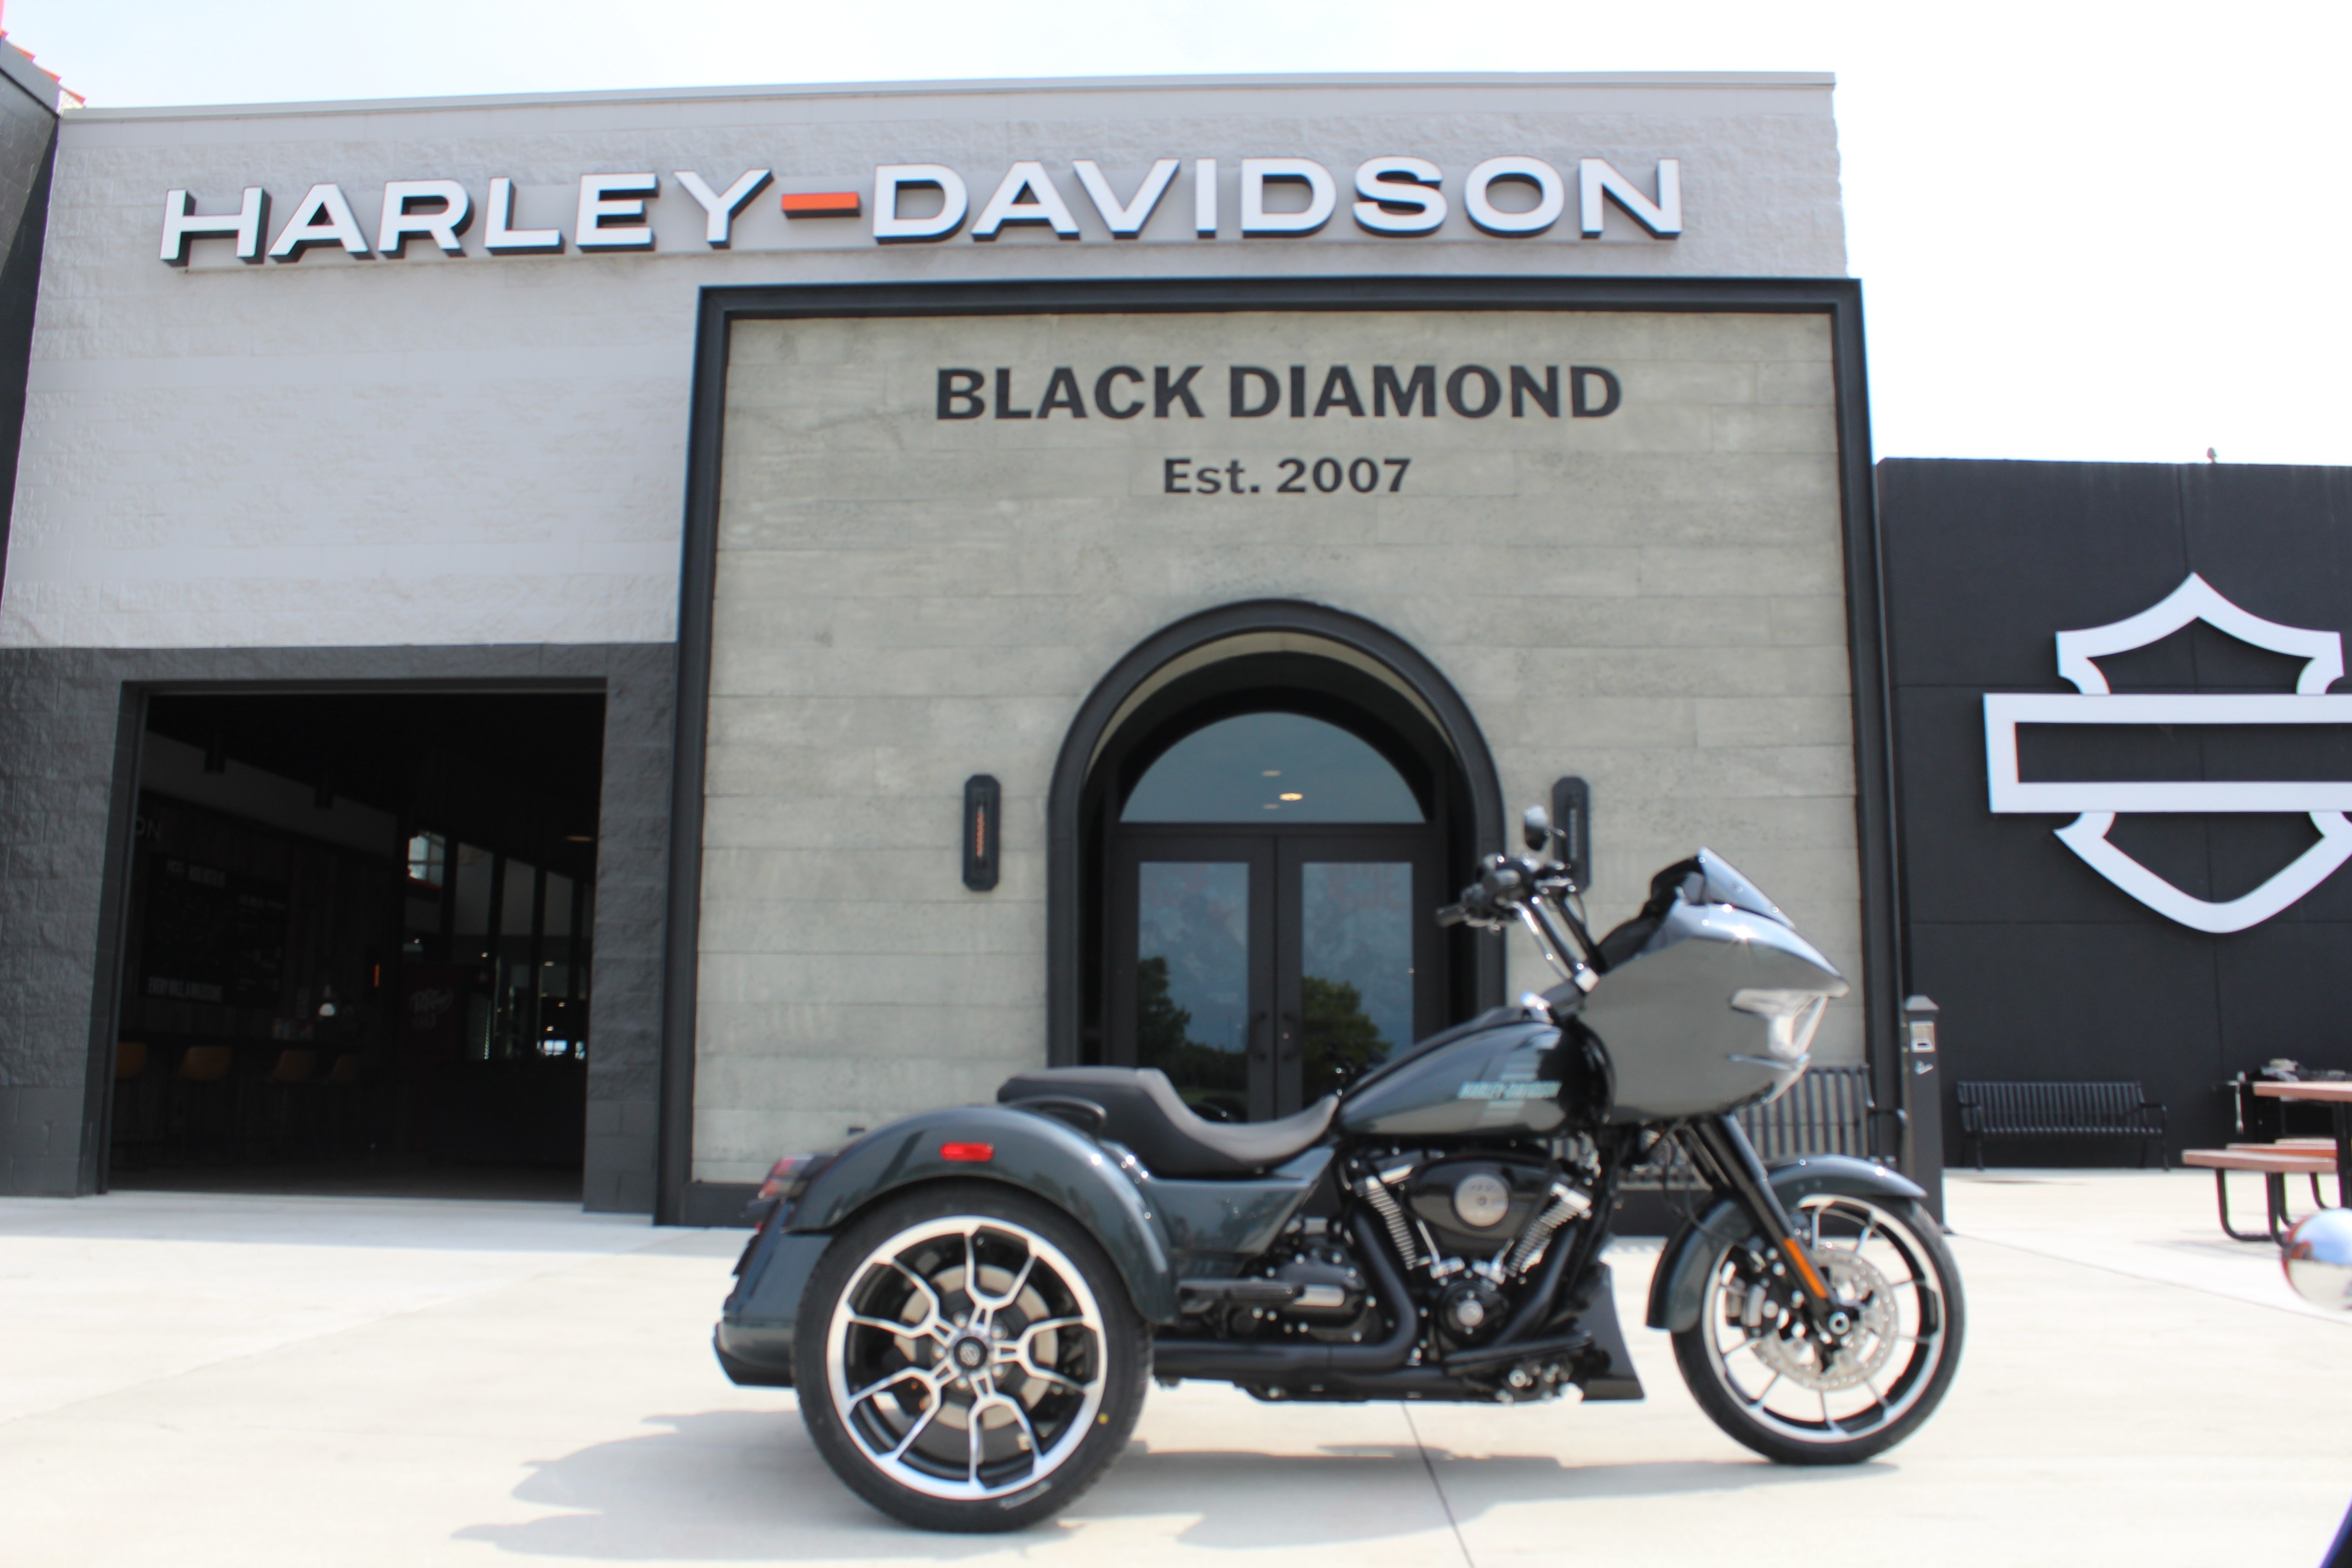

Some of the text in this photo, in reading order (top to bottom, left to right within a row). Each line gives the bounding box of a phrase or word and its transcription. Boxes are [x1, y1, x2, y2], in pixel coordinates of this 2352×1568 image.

[160, 155, 1683, 268] HARLEY-DAVIDSON
[936, 364, 1622, 421] BLACK DIAMOND
[1163, 456, 1411, 494] Est. 2007
